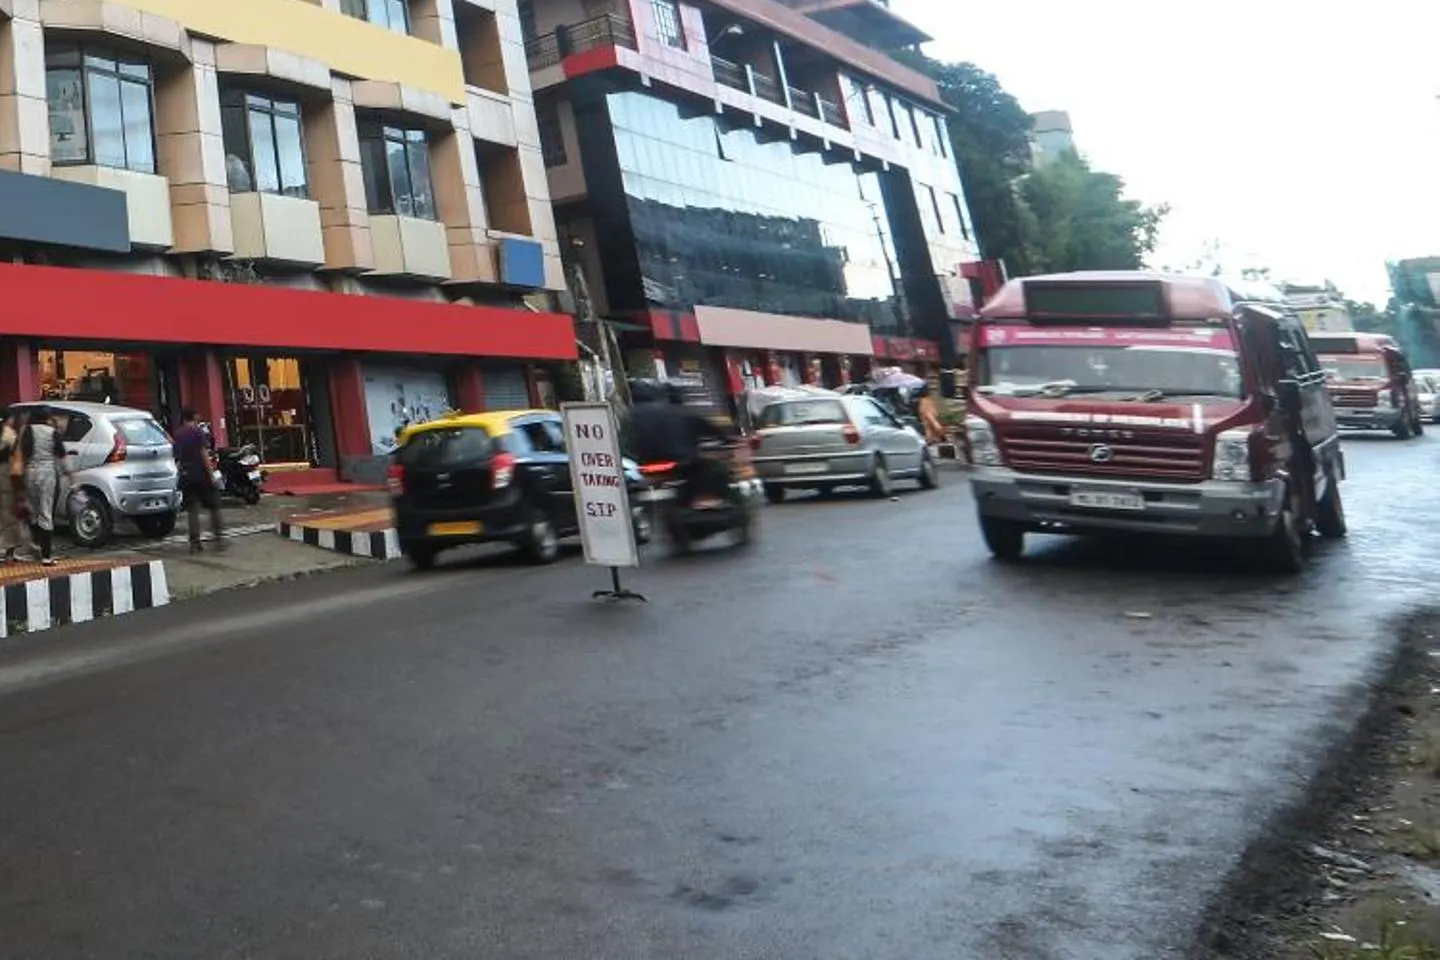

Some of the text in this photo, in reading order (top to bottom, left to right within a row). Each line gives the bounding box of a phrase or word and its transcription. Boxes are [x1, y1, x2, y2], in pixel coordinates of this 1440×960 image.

[575, 423, 604, 440] NO
[581, 452, 613, 467] OVER
[580, 473, 620, 487] TAKING
